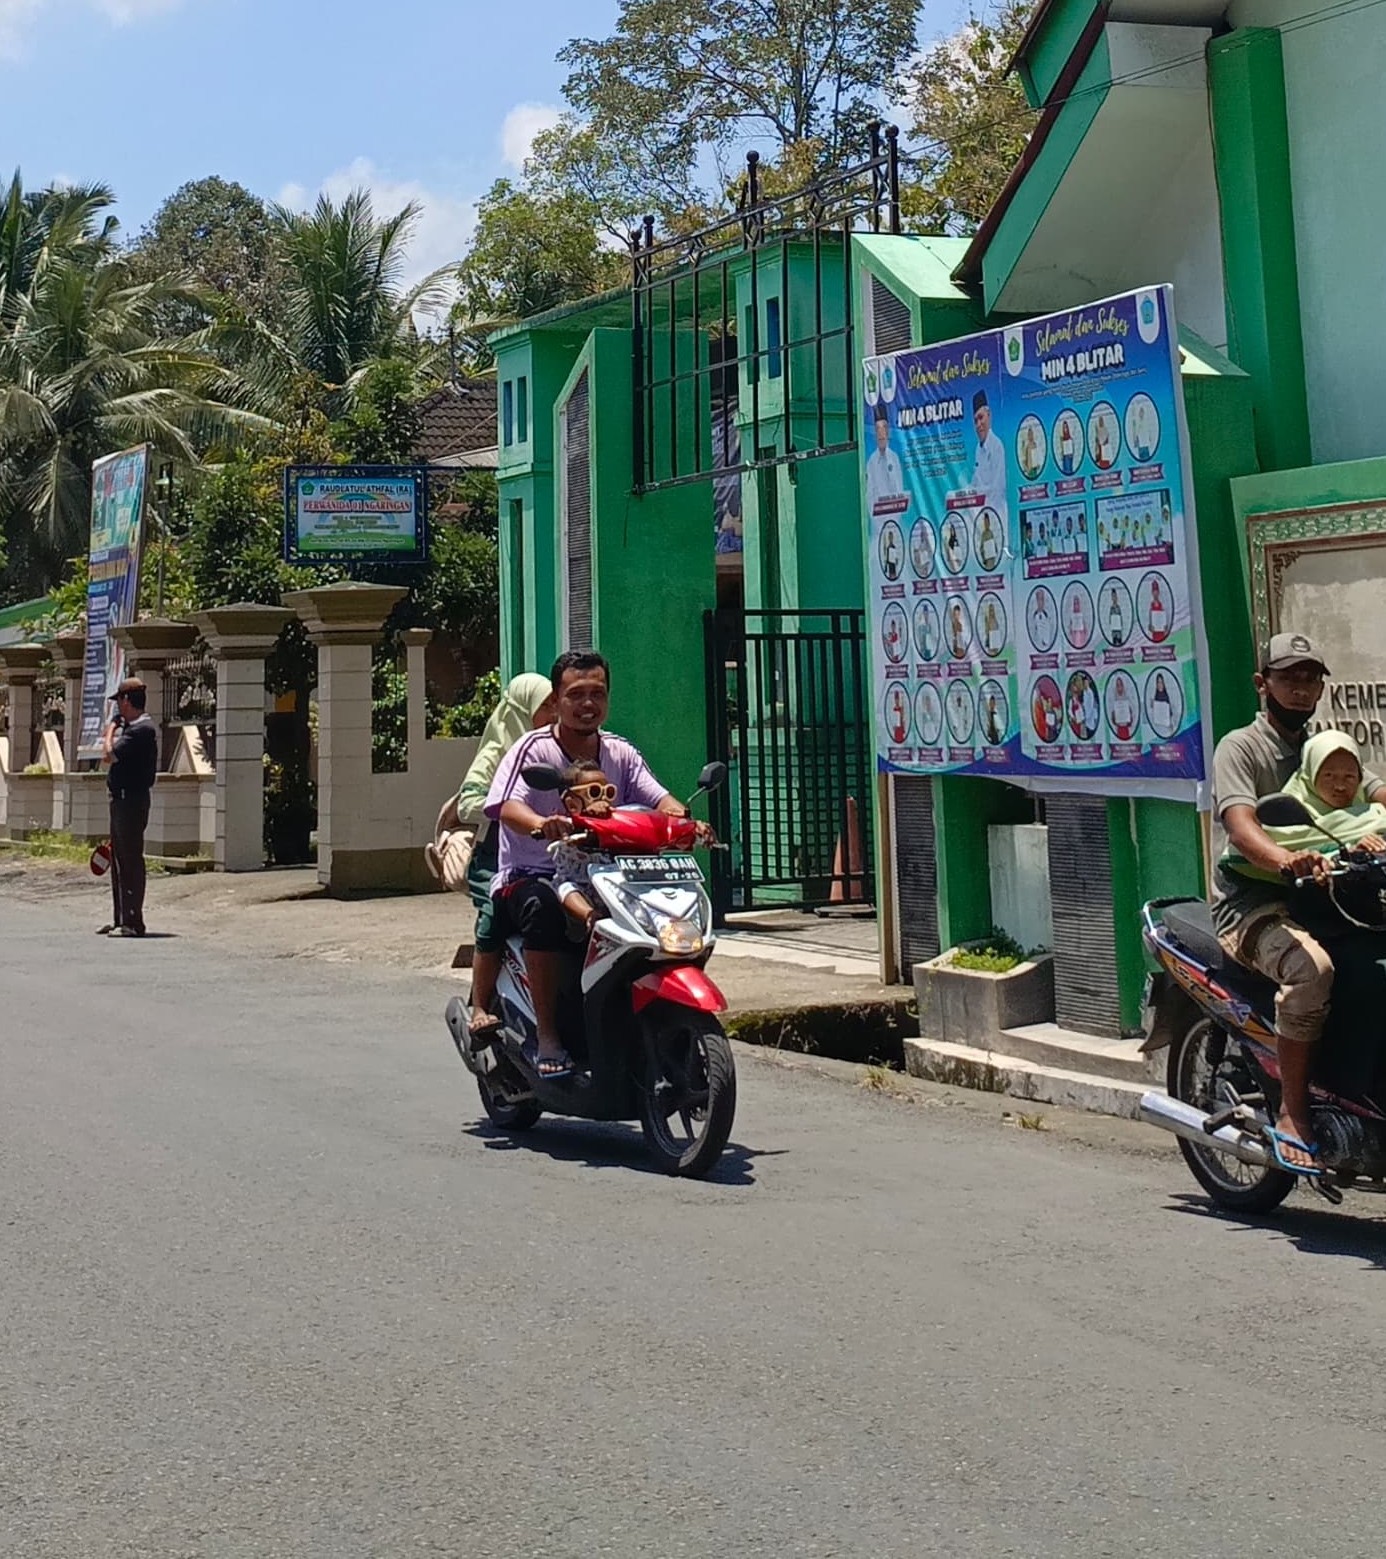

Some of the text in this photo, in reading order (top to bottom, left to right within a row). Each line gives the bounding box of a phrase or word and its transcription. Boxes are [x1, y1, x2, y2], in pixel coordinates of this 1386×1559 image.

[1036, 307, 1129, 357] Selamat dan Sukses
[907, 360, 941, 389] Selamat
[1041, 343, 1125, 381] MIN 4 BLITAR
[917, 406, 925, 423] 4
[925, 399, 963, 422] BLITAR
[1307, 720, 1383, 746] ATOR
